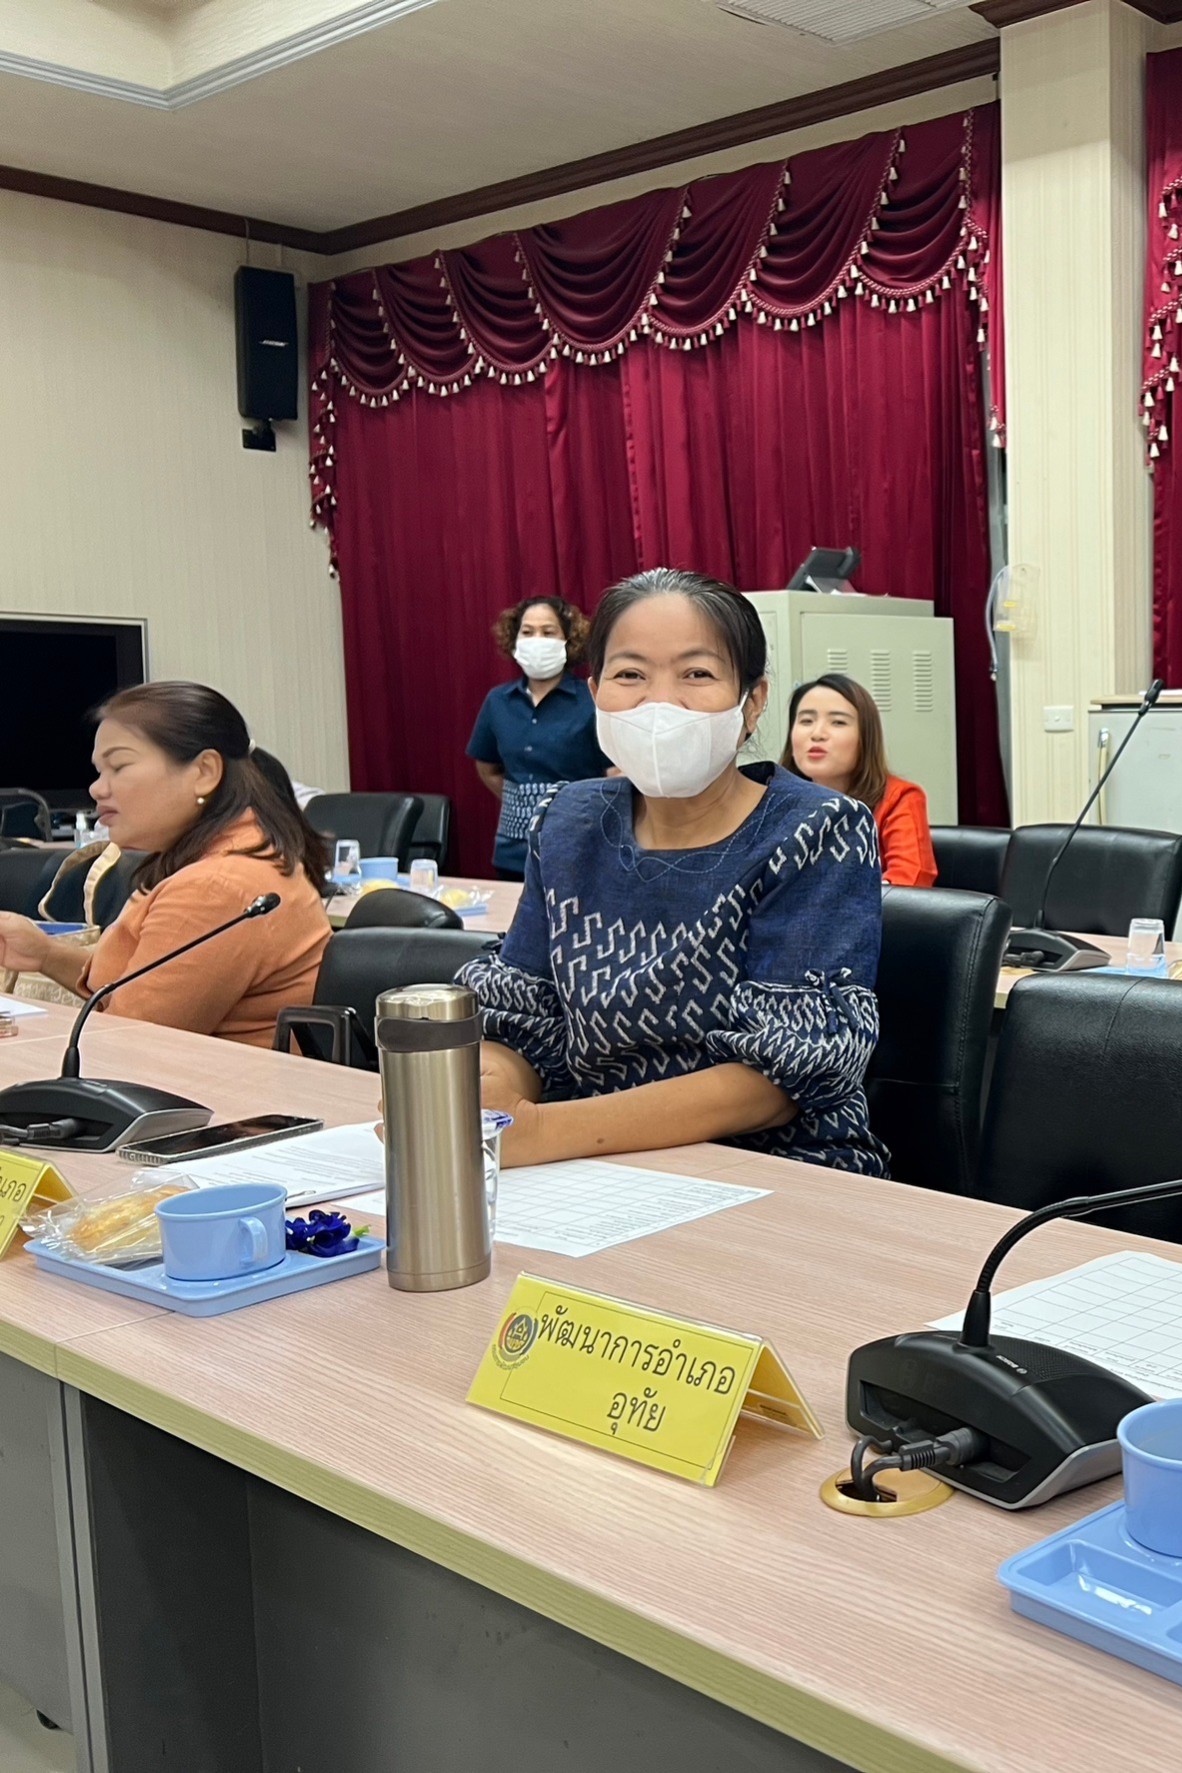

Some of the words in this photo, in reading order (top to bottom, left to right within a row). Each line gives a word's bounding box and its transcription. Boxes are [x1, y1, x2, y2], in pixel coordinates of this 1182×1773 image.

[538, 1305, 736, 1395] พัฒนาการอำเภอ
[606, 1386, 667, 1435] อุทัย
